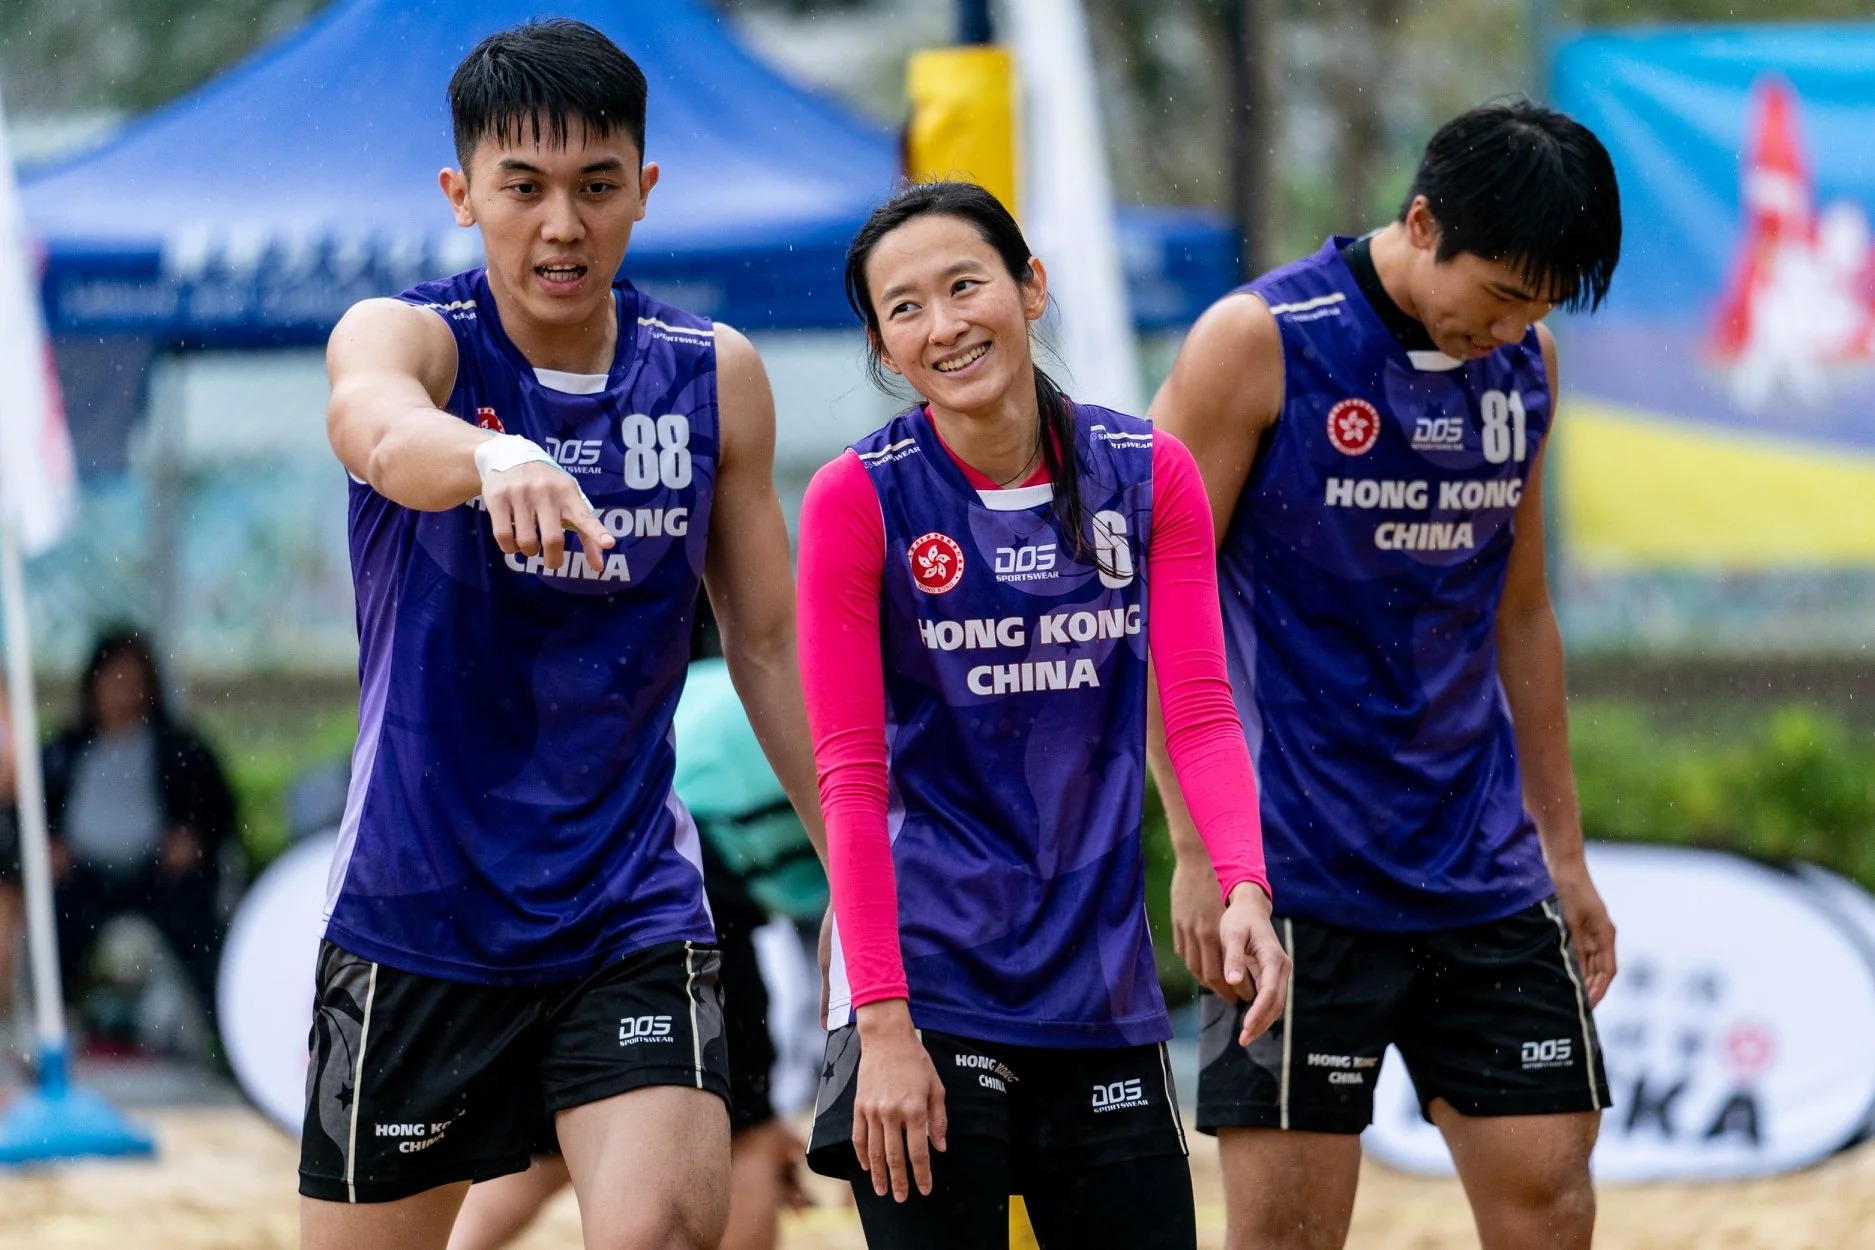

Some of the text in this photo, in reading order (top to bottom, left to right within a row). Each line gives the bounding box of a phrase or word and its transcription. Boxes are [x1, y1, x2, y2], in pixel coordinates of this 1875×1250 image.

[1412, 416, 1464, 442] DOS
[1480, 389, 1527, 464] 81
[545, 436, 603, 465] DOS
[621, 413, 693, 490] 88
[1324, 477, 1522, 510] HONG KONG
[1092, 509, 1134, 590] 6
[1373, 521, 1475, 551] CHINA
[995, 543, 1057, 573] DOS
[996, 571, 1060, 582] SPORTSWEAR
[917, 604, 1141, 651] HONG KONG
[967, 658, 1100, 696] CHINA
[619, 1015, 672, 1040] DOS
[619, 1036, 674, 1047] SPORTSWEAR
[1307, 1051, 1352, 1069] HONG
[1521, 1037, 1572, 1062] DOS
[1091, 1078, 1142, 1107] DOS
[1093, 1099, 1149, 1114] SPORTSWEAR
[375, 1123, 425, 1137] HONG
